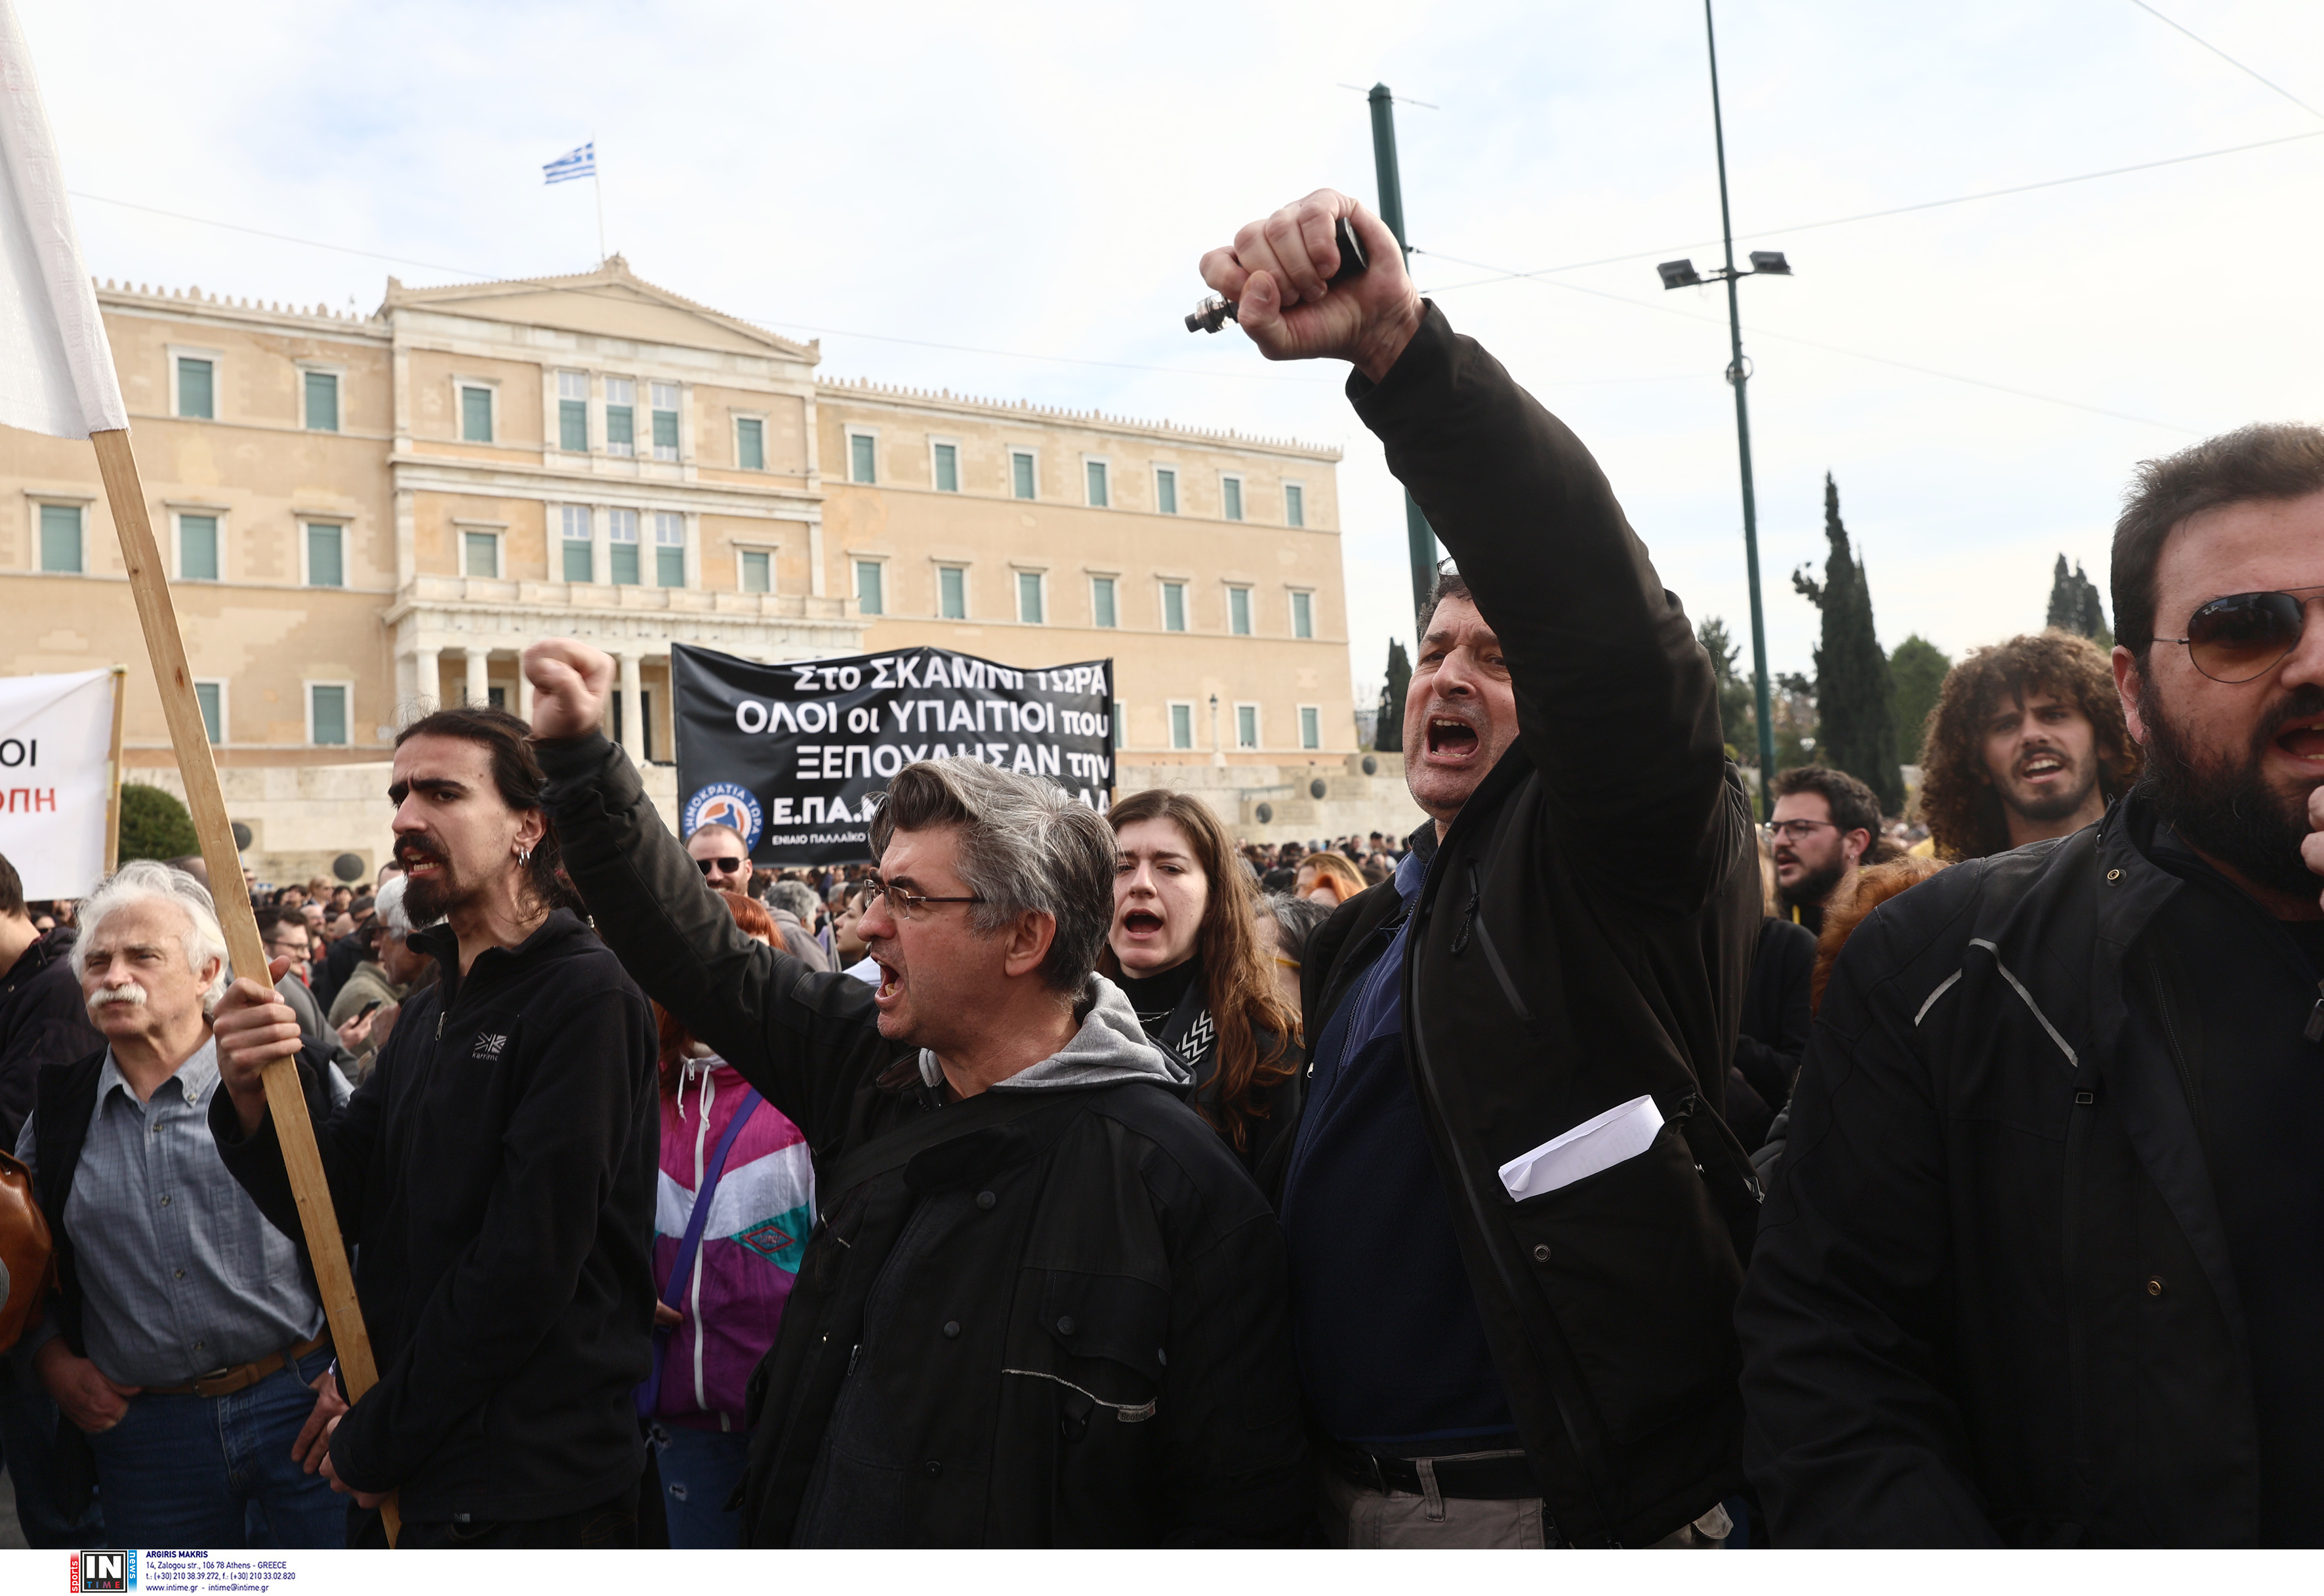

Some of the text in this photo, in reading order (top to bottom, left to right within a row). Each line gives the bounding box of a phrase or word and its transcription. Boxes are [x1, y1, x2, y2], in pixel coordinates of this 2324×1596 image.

[791, 665, 861, 691] Στο
[870, 656, 1024, 690] ΣΚΑΜΝΙ
[735, 699, 1109, 738] ΟΛΟΙ οι ΥΠΑΙΤΙΟΙ που
[1066, 752, 1110, 786] την
[0, 788, 56, 813] ΠΗ
[772, 834, 808, 846] ΕΝΙΑΙΟ
